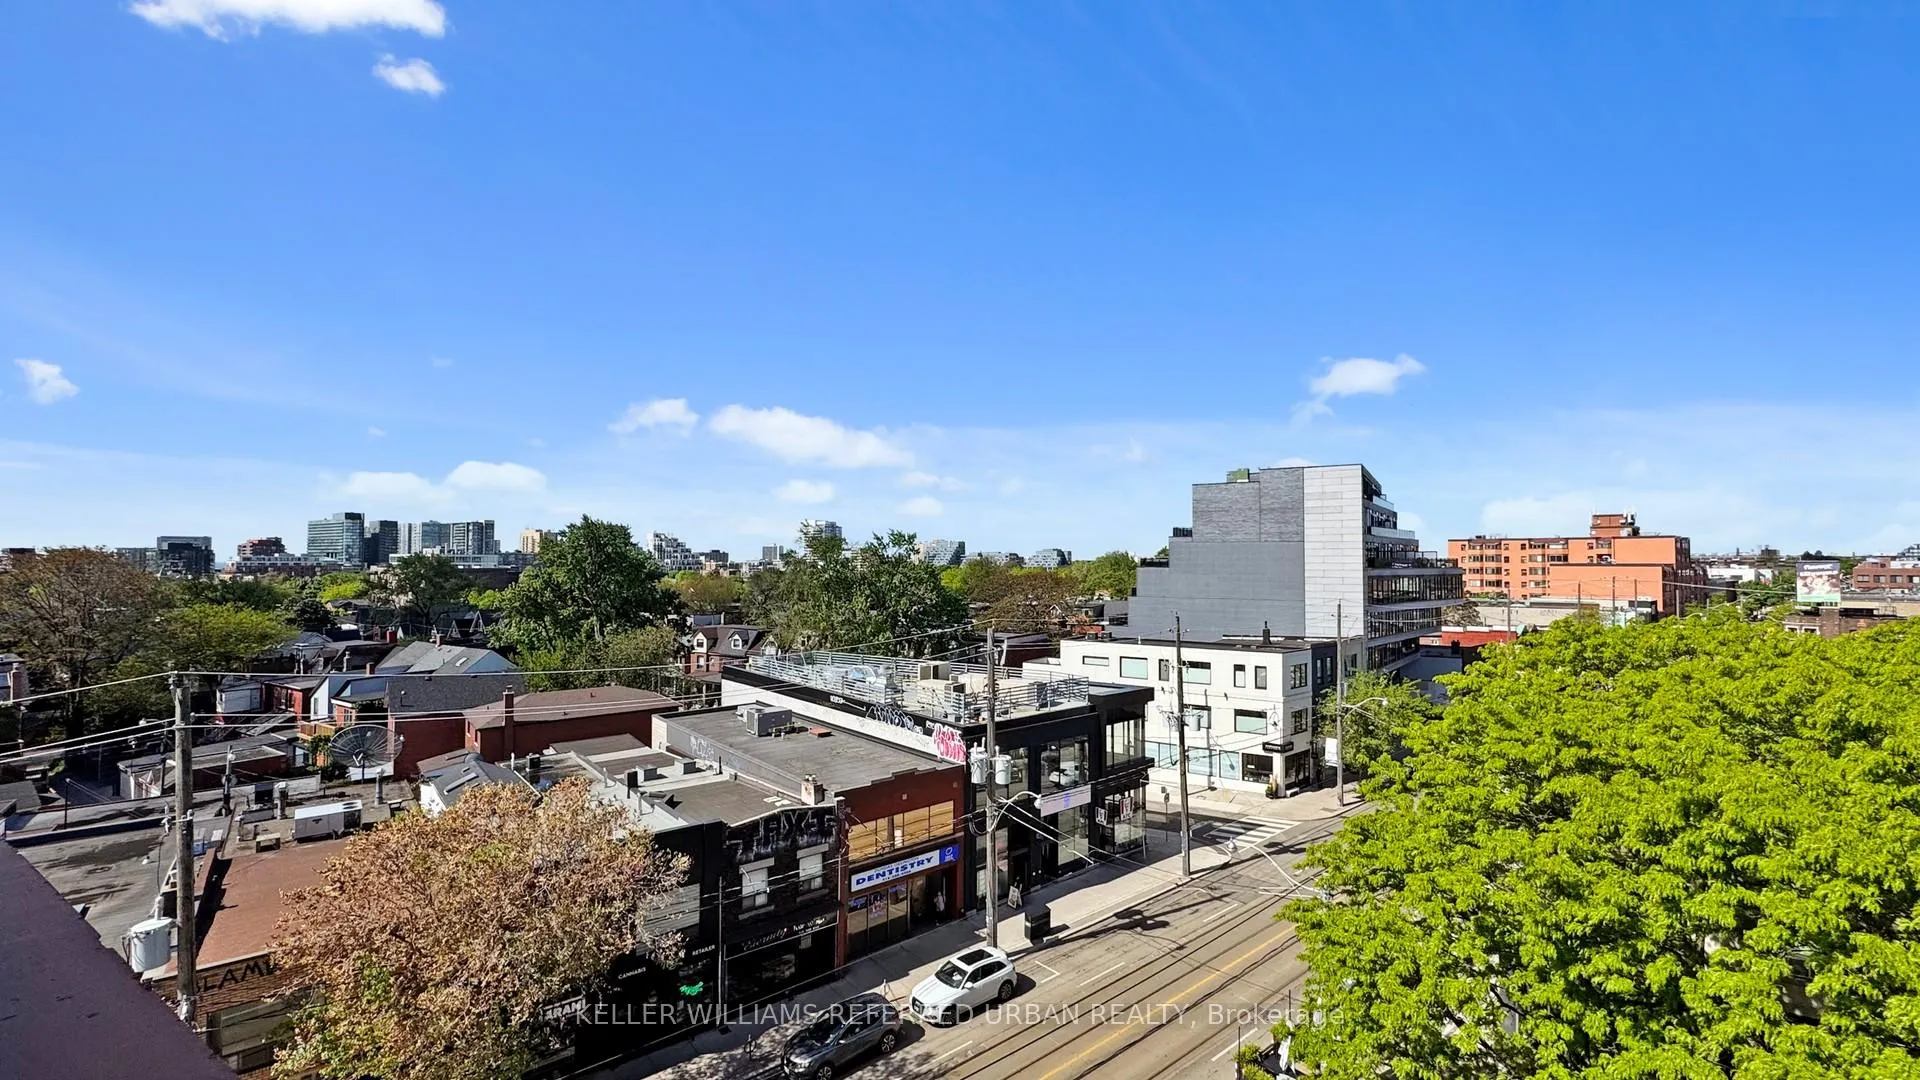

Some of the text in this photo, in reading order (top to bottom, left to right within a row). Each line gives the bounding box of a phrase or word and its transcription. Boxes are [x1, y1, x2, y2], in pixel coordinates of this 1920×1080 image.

[855, 855, 934, 886] DENTISTRY
[692, 944, 716, 956] RETAILER
[618, 966, 647, 979] CANNABIS
